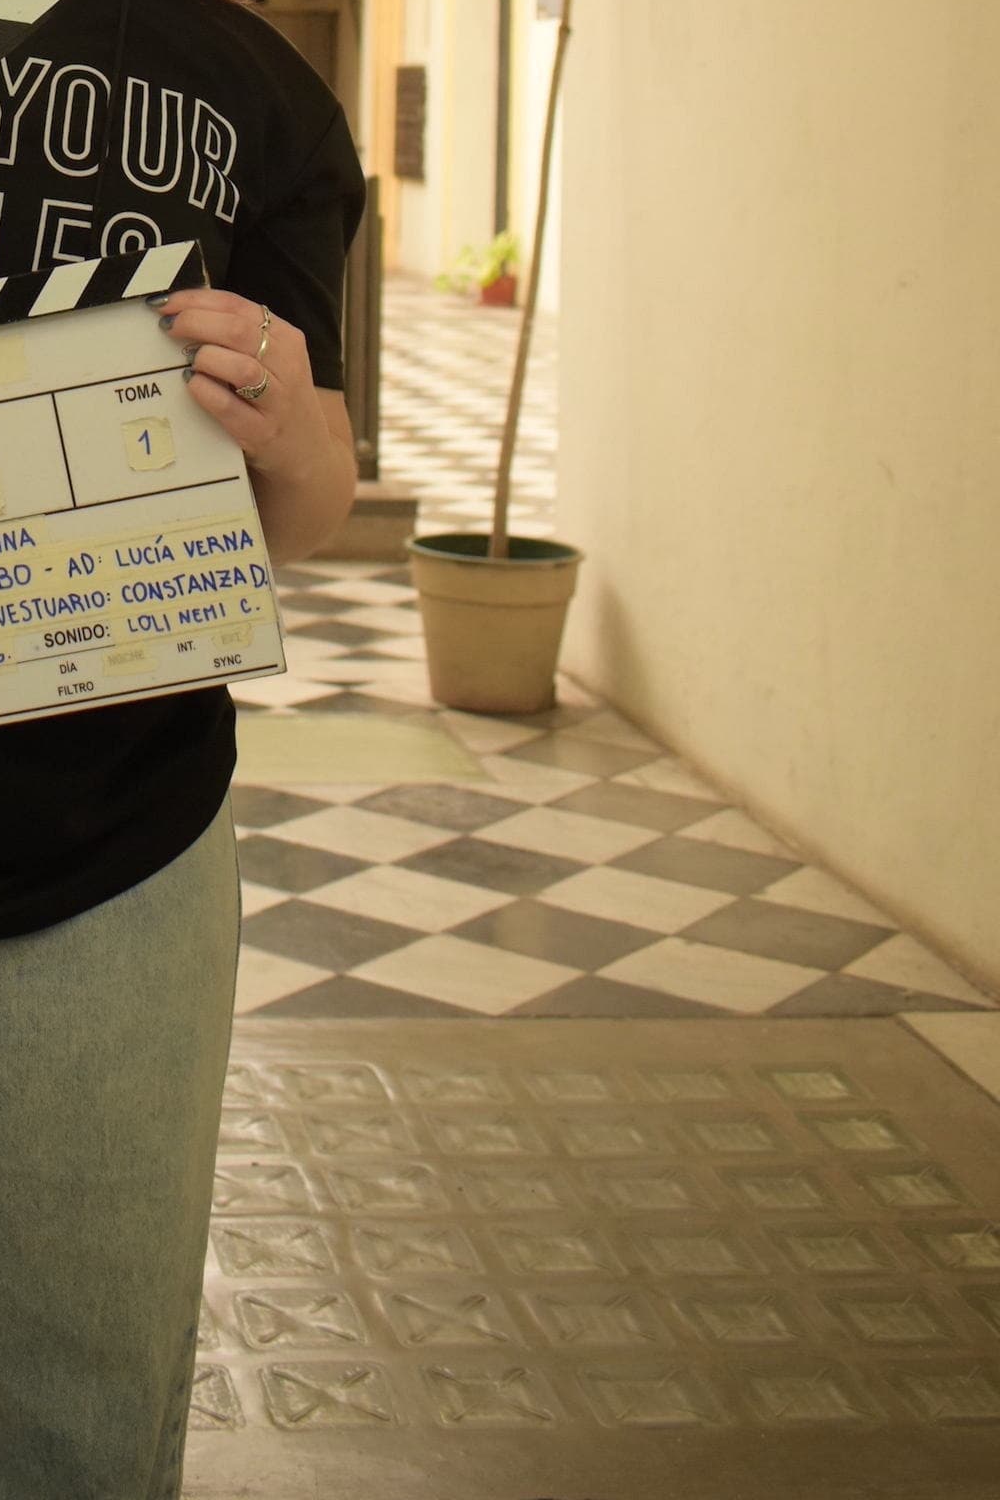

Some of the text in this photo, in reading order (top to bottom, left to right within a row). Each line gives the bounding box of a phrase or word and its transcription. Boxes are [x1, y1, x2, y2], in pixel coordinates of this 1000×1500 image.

[114, 382, 162, 404] TOMA
[137, 429, 152, 455] 1
[67, 552, 103, 579] AD:
[115, 534, 175, 567] LUCÍA
[183, 528, 254, 559] VERNA
[121, 566, 248, 604] CONSTANZA
[249, 563, 269, 589] D.
[127, 613, 172, 633] LOLI
[179, 602, 227, 625] NEMI
[43, 623, 111, 648] SONIDO:
[176, 640, 197, 653] INT.
[59, 660, 78, 675] DÍA
[213, 653, 243, 668] SYNC
[57, 680, 95, 697] FILTRO
